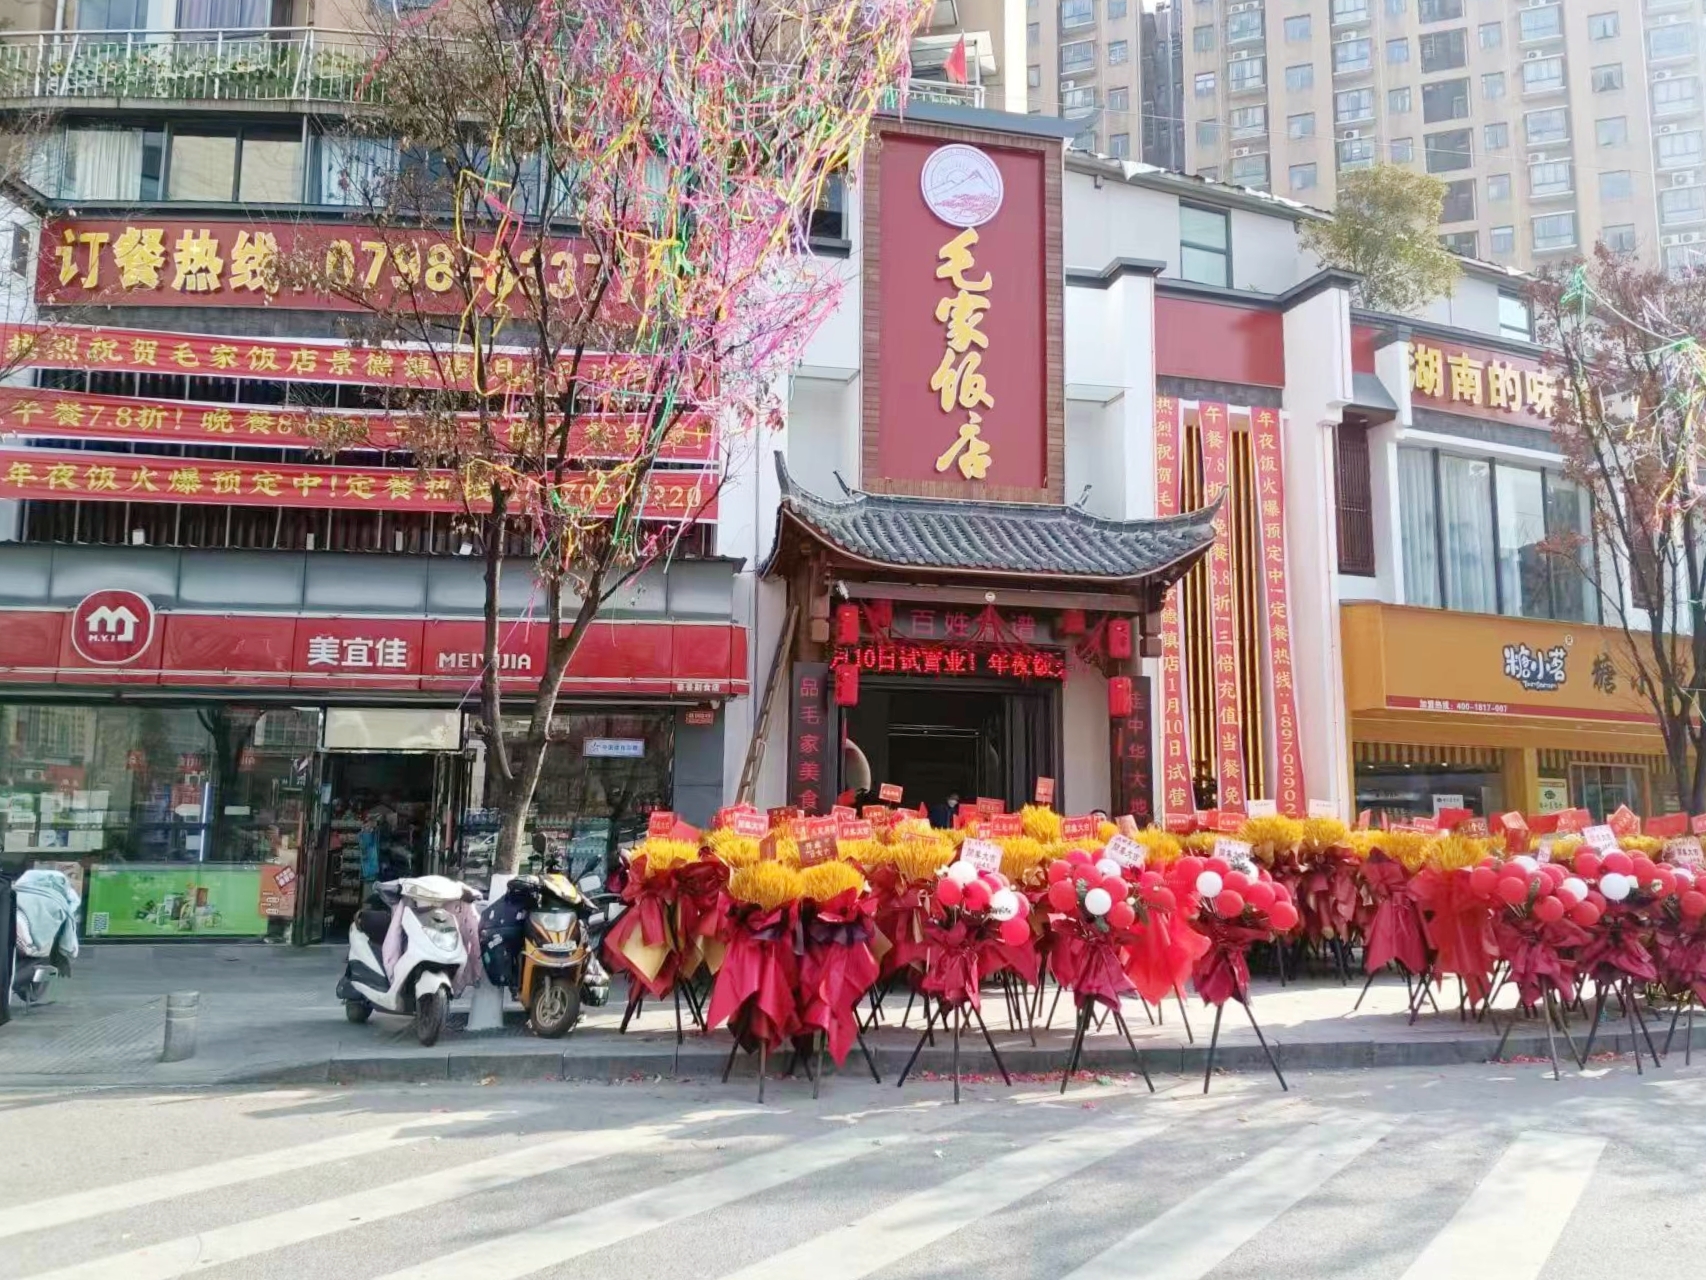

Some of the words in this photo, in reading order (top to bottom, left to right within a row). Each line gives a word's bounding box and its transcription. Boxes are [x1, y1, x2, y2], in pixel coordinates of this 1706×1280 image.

[931, 227, 995, 480] 毛家饭店
[1408, 341, 1592, 425] 湖南的味
[307, 637, 407, 668] 美宜佳
[438, 652, 531, 669] MEIIJIA
[1503, 644, 1566, 681] 糖小茗
[800, 676, 821, 811] 品毛家美食
